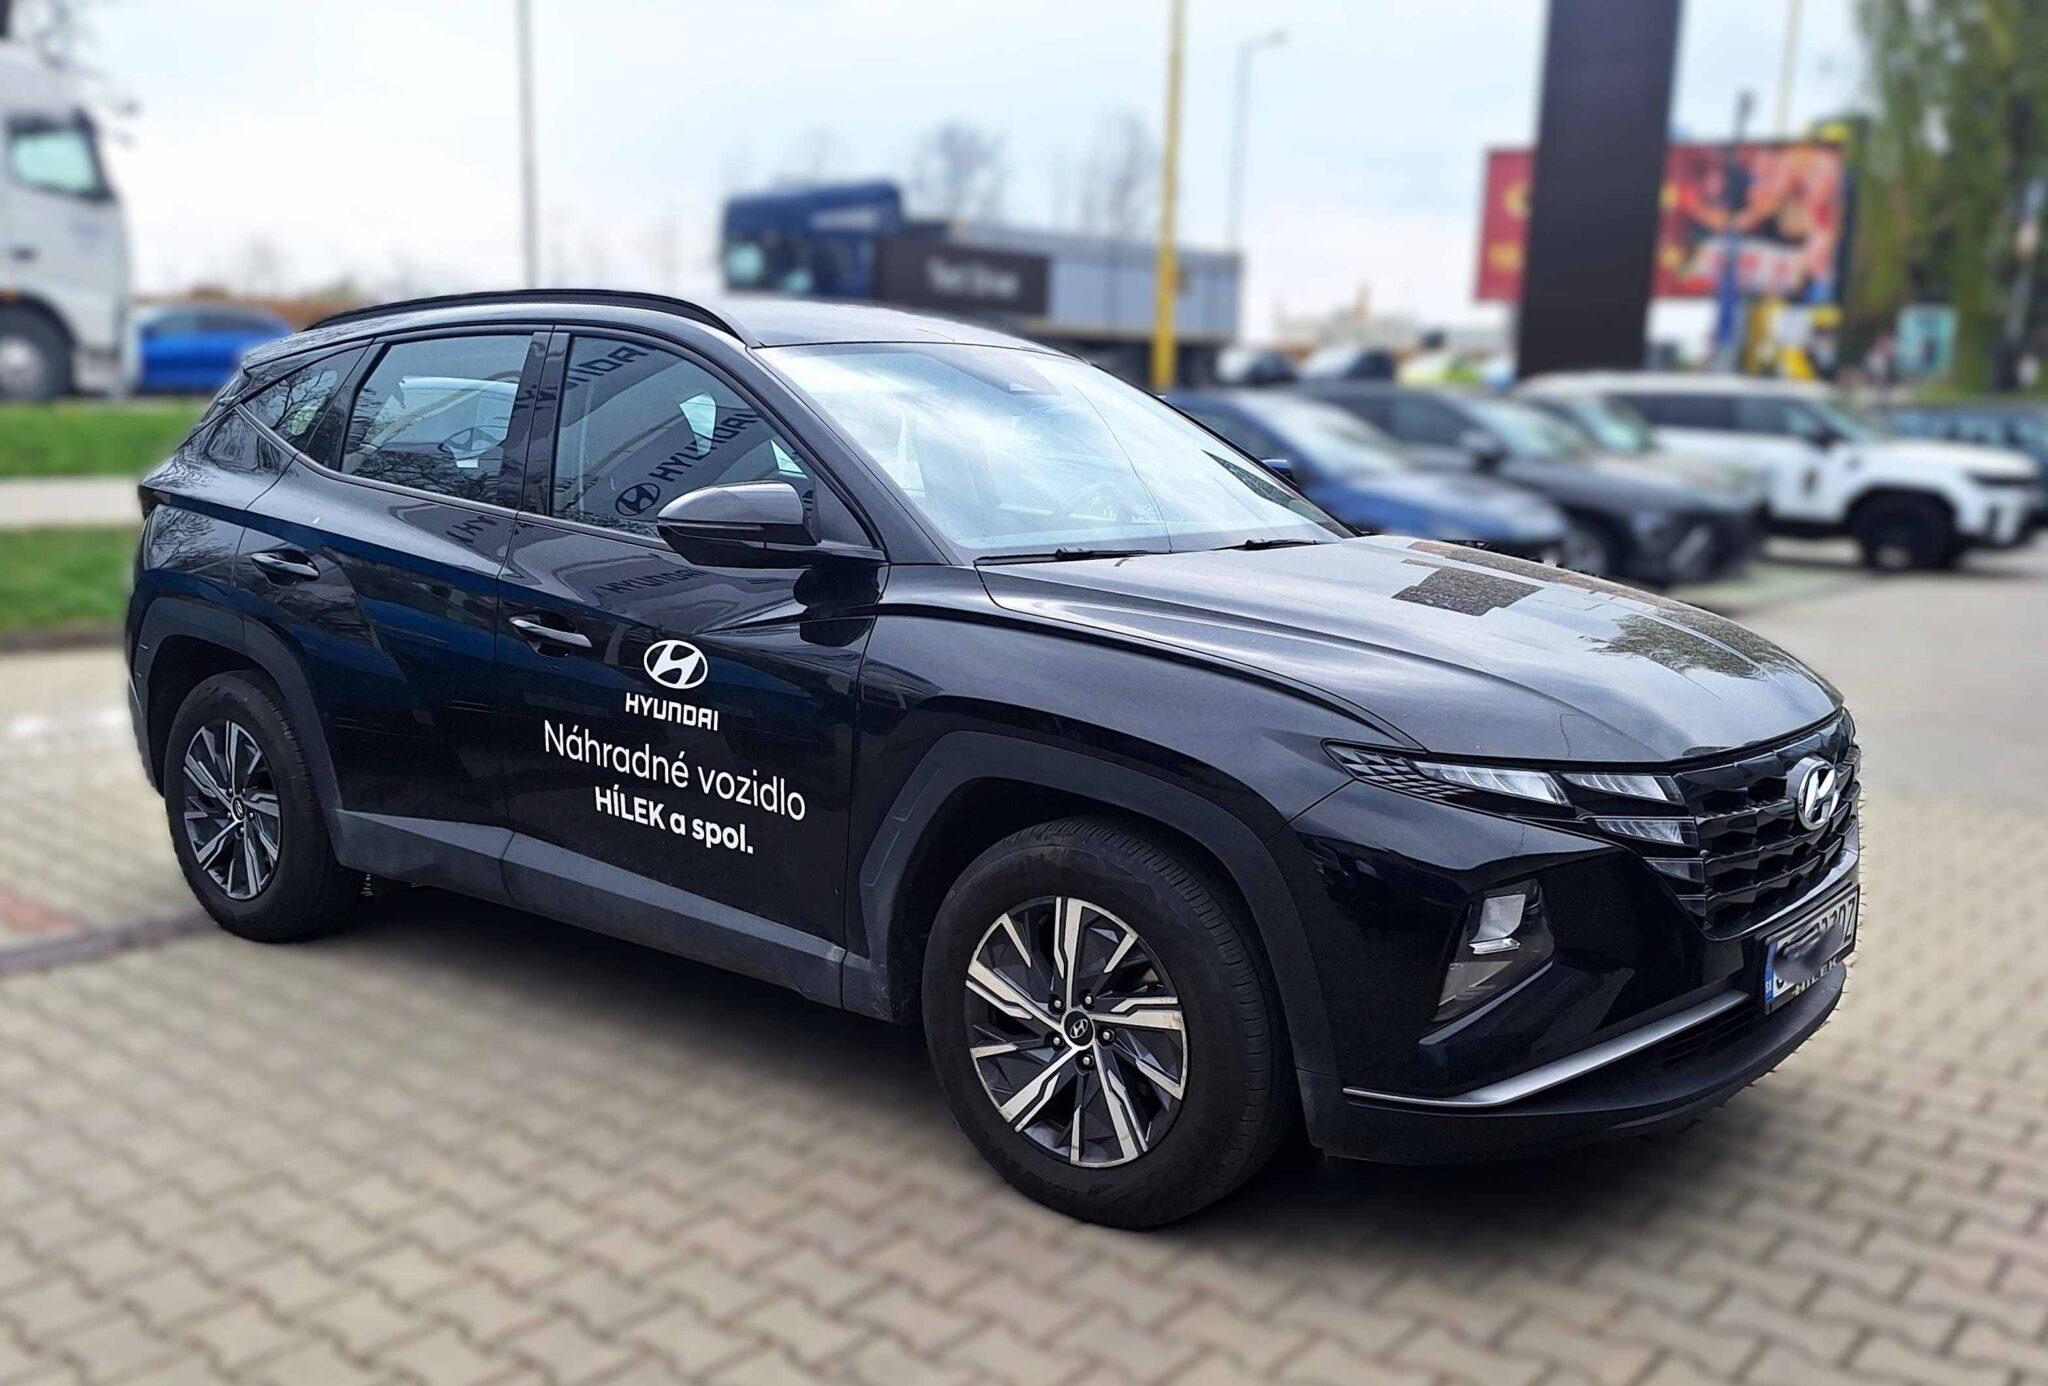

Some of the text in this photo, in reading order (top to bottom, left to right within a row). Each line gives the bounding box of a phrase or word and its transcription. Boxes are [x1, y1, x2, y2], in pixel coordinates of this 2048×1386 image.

[625, 692, 719, 731] HYUNDAI
[544, 720, 806, 821] Náhradné vozidlo
[595, 784, 754, 854] HÍLEK a spol.
